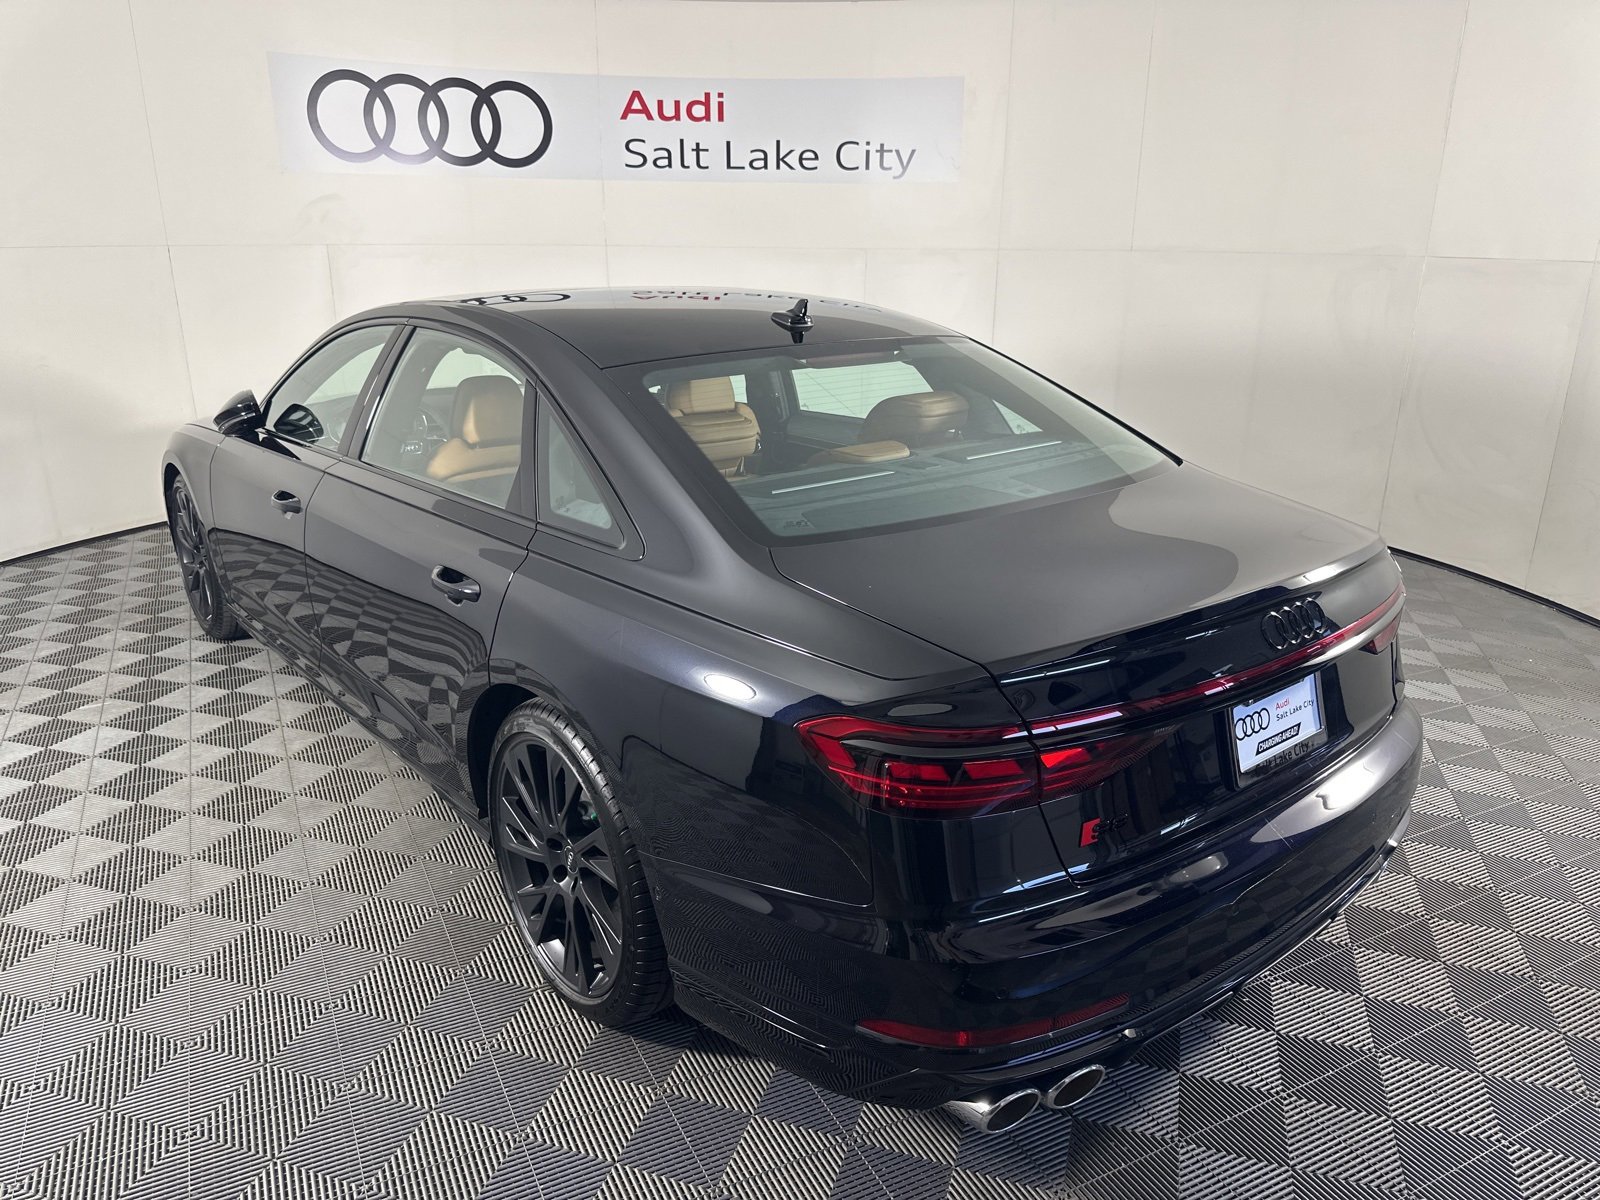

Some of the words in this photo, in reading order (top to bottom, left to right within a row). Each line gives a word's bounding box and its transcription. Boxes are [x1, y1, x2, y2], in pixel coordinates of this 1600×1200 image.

[620, 90, 725, 122] Audi
[624, 138, 710, 170] Salt
[725, 139, 820, 171] Lake
[835, 140, 917, 180] City
[1275, 698, 1290, 710] Audi
[1276, 711, 1288, 722] Salt
[1289, 704, 1302, 714] Lake
[1303, 699, 1315, 708] City
[1293, 741, 1309, 757] City
